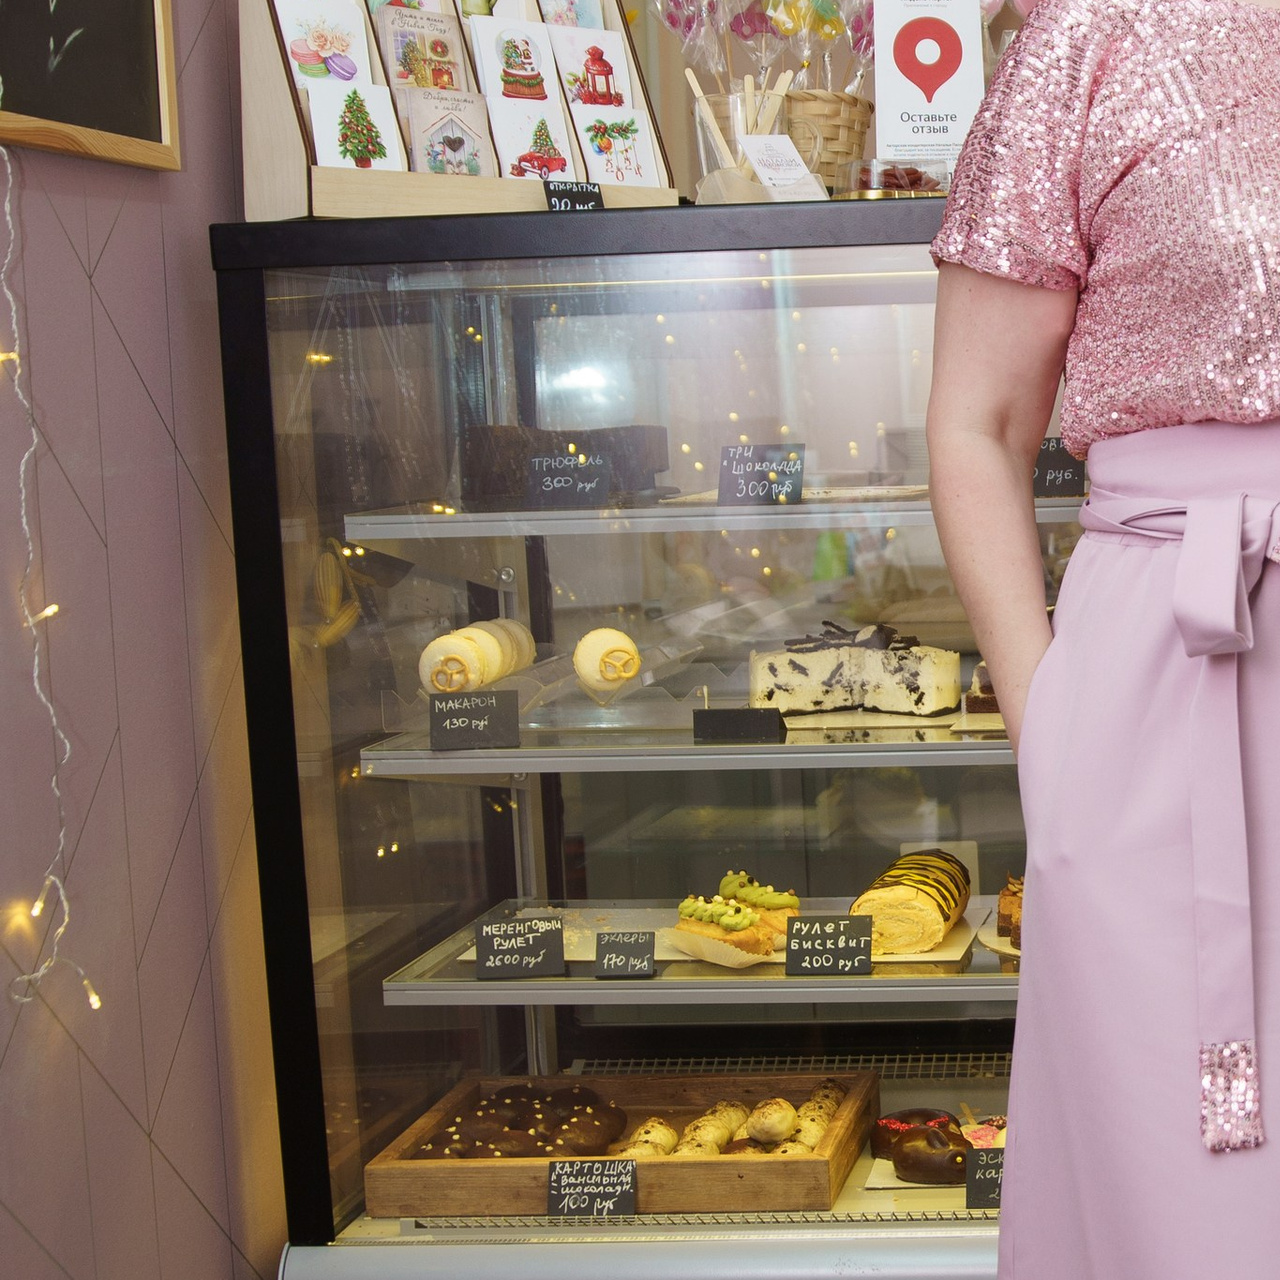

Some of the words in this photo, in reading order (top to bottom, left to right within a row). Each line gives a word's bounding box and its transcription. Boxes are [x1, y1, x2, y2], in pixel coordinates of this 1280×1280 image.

[900, 111, 957, 123] Оставьте
[911, 125, 949, 134] отзыв
[549, 181, 599, 193] ОТКРЫТКА
[728, 446, 753, 458] ТРИ
[542, 476, 573, 491] 300
[434, 696, 496, 713] МАКАРОН
[442, 718, 469, 730] 130
[493, 933, 541, 950] РУЛЕТ
[485, 953, 520, 967] 2600
[602, 953, 626, 969] 170
[801, 954, 833, 968] 200
[838, 956, 866, 971] руб
